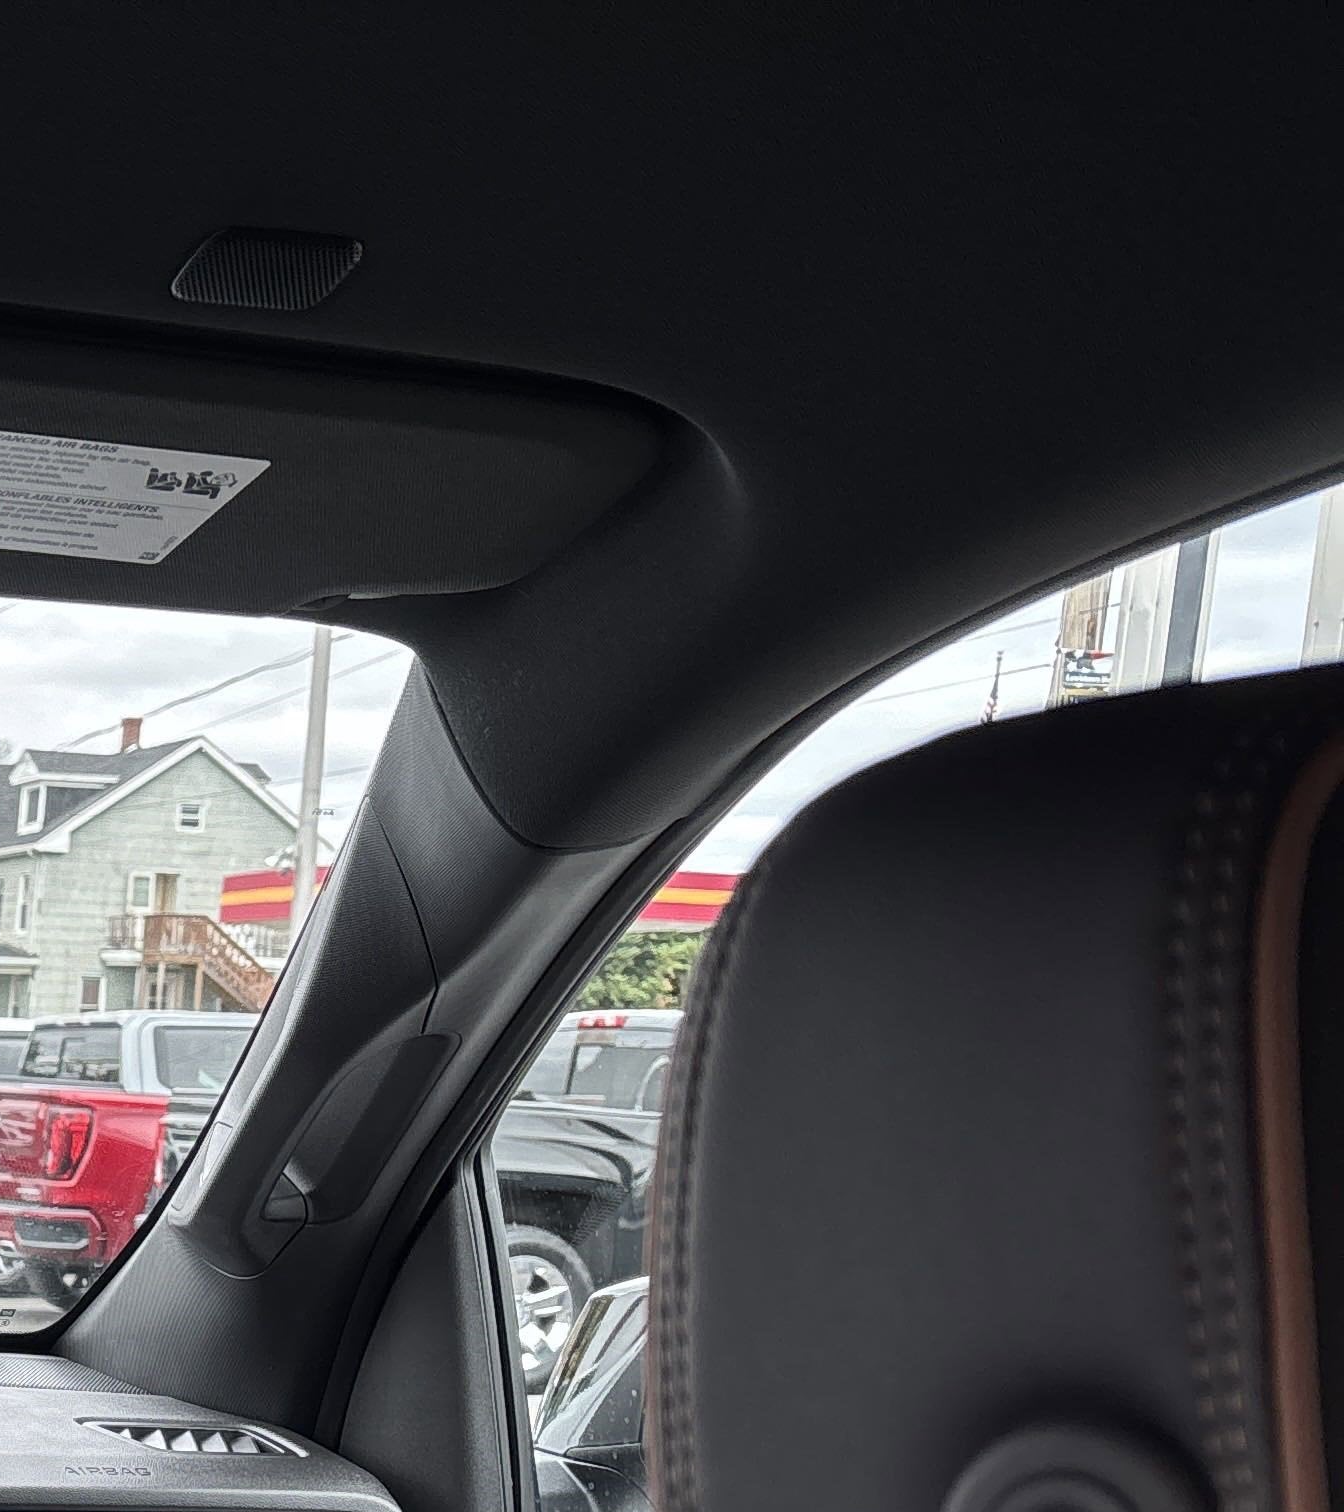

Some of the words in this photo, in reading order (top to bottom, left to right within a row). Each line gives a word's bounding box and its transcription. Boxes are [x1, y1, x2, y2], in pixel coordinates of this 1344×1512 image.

[52, 439, 78, 449] AIR
[79, 441, 120, 453] BAGS
[73, 497, 160, 513] INTELLIGENTS
[64, 1466, 152, 1476] AIRBAG
